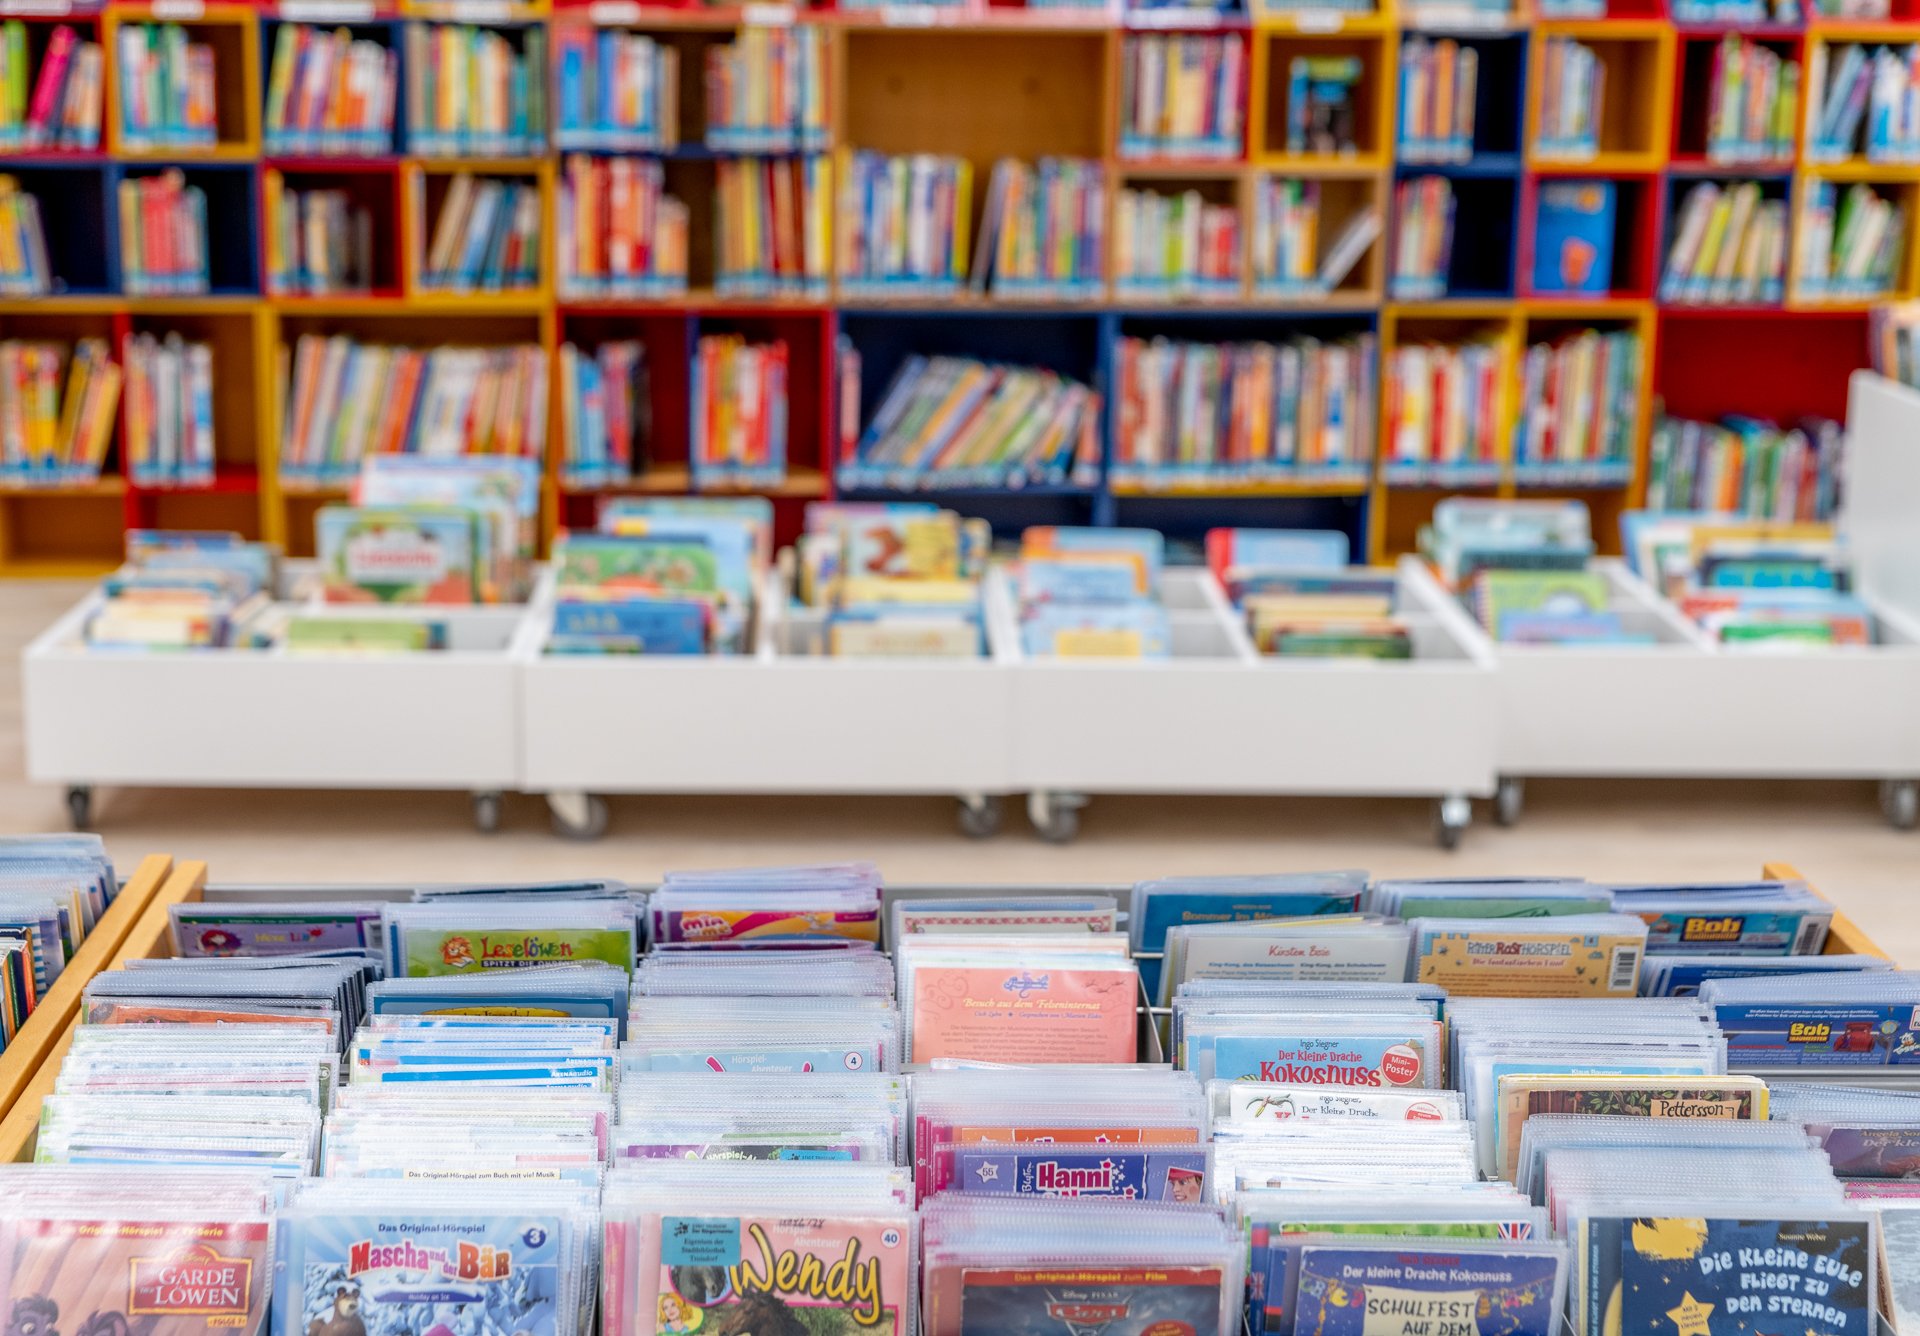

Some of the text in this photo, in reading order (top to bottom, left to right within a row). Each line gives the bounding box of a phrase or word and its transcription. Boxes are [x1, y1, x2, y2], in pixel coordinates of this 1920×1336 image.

[1686, 918, 1741, 932] Bob
[481, 936, 573, 959] Leselöwen
[1268, 944, 1305, 957] Kirsten
[1014, 999, 1033, 1008] dem
[1790, 1022, 1830, 1036] Bob
[1300, 1039, 1340, 1050] Ingo Siegner
[850, 1057, 857, 1065] 4
[1278, 1050, 1296, 1061] Der
[1330, 1051, 1363, 1063] Drache
[1391, 1056, 1411, 1067] Mini-
[1386, 1063, 1414, 1077] Poster
[1301, 1105, 1317, 1114] Der
[1660, 1101, 1724, 1118] Pettersson
[982, 1168, 994, 1177] 55
[1038, 1162, 1111, 1189] Hanni
[378, 1223, 485, 1235] Das Original-Hörspiel
[529, 1230, 540, 1244] 3
[884, 1233, 898, 1244] 40
[350, 1240, 430, 1276] Mascha
[159, 1266, 236, 1287] GARDE
[729, 1222, 880, 1325] Wendy
[1145, 1272, 1168, 1281] Film
[1343, 1265, 1513, 1284] Der kleine Drache Kokosnuss
[154, 1284, 241, 1306] LÖWEN
[1368, 1298, 1476, 1320] SCHULFEST
[1402, 1321, 1473, 1336] AUF DEM
